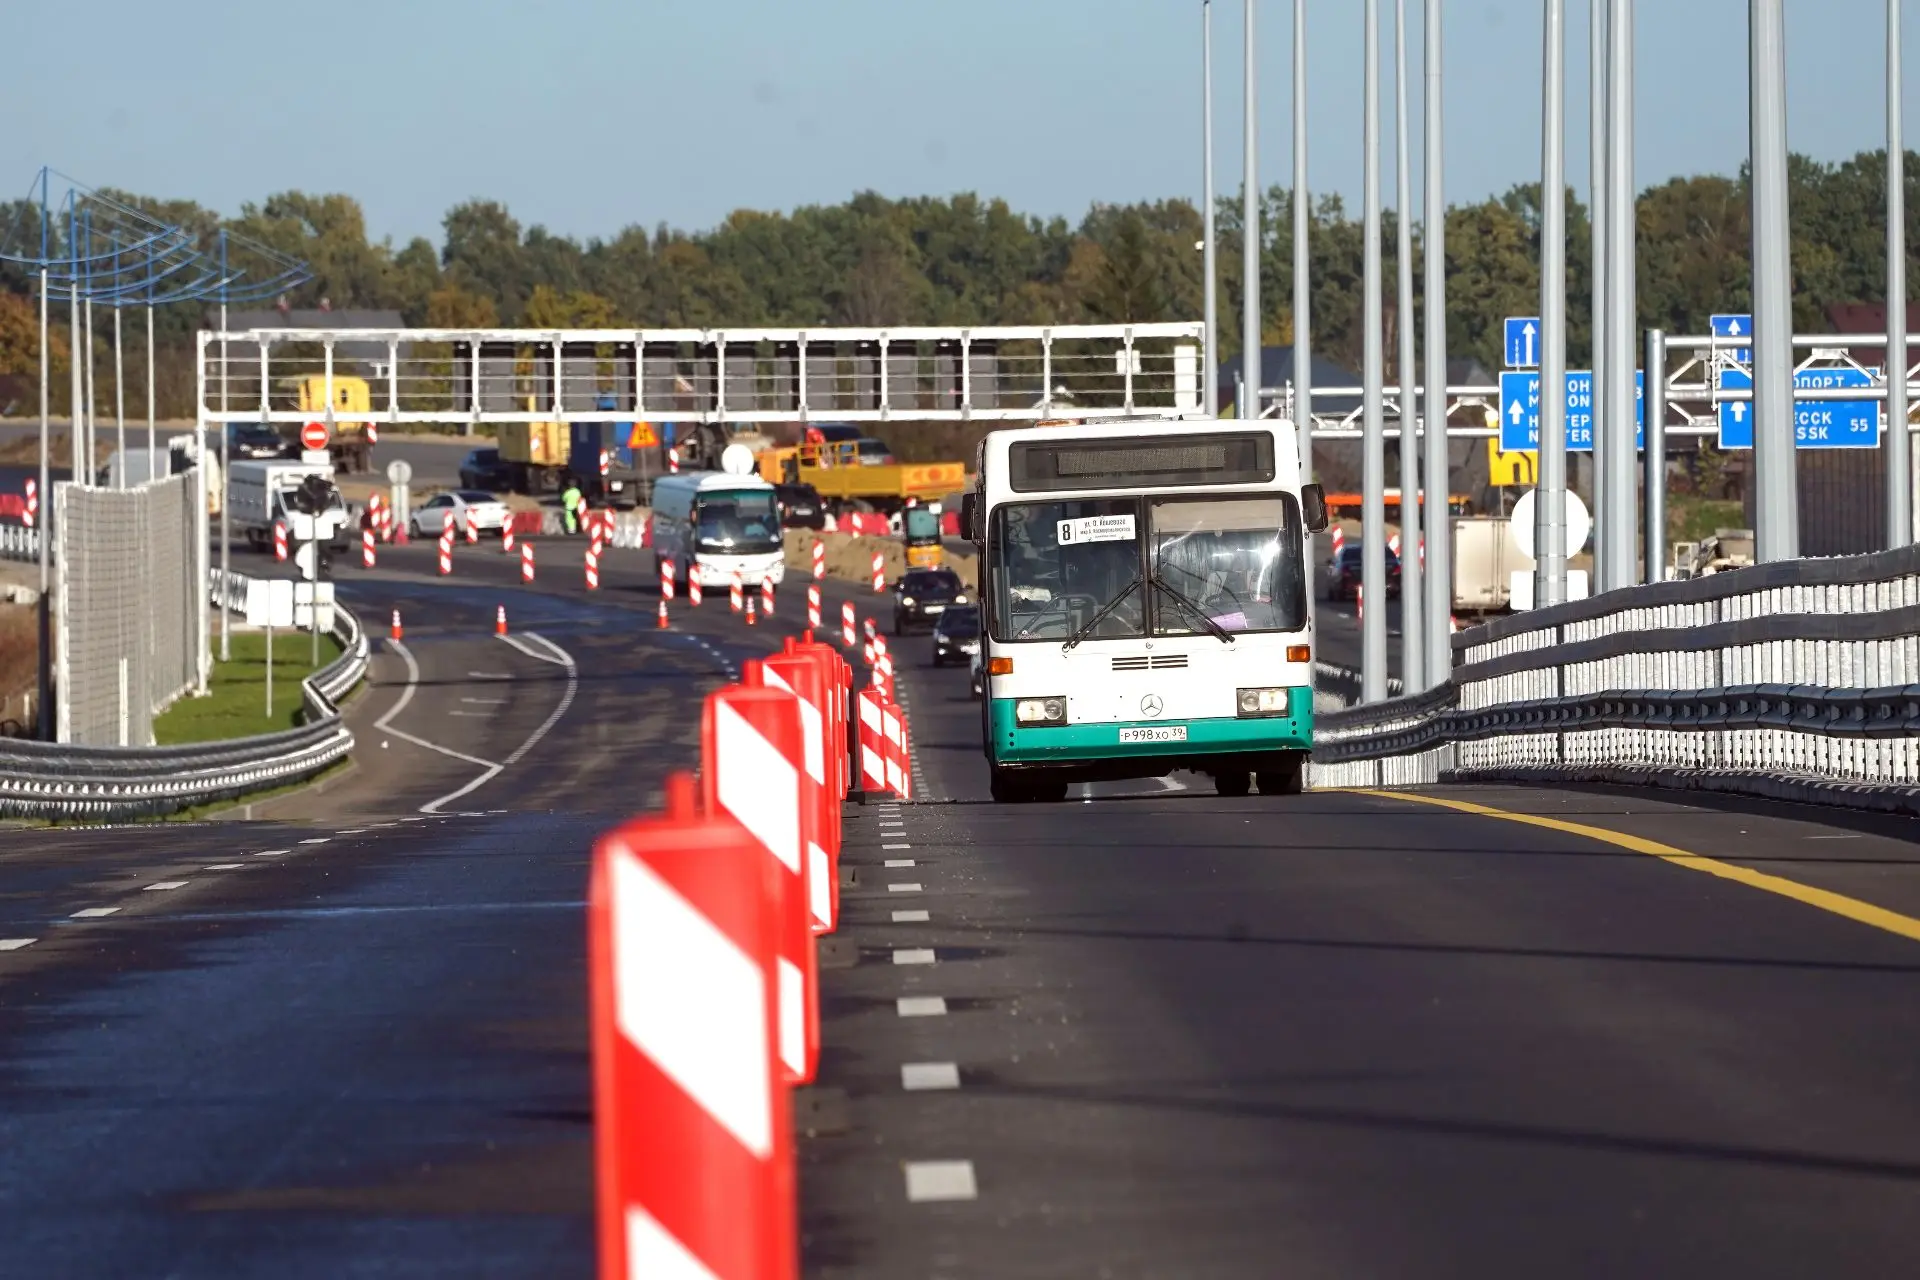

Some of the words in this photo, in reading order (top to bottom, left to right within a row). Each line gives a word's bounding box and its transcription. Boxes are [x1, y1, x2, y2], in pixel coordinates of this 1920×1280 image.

[1850, 418, 1868, 432] 55
[1062, 523, 1071, 541] 8
[1171, 727, 1183, 737] 39
